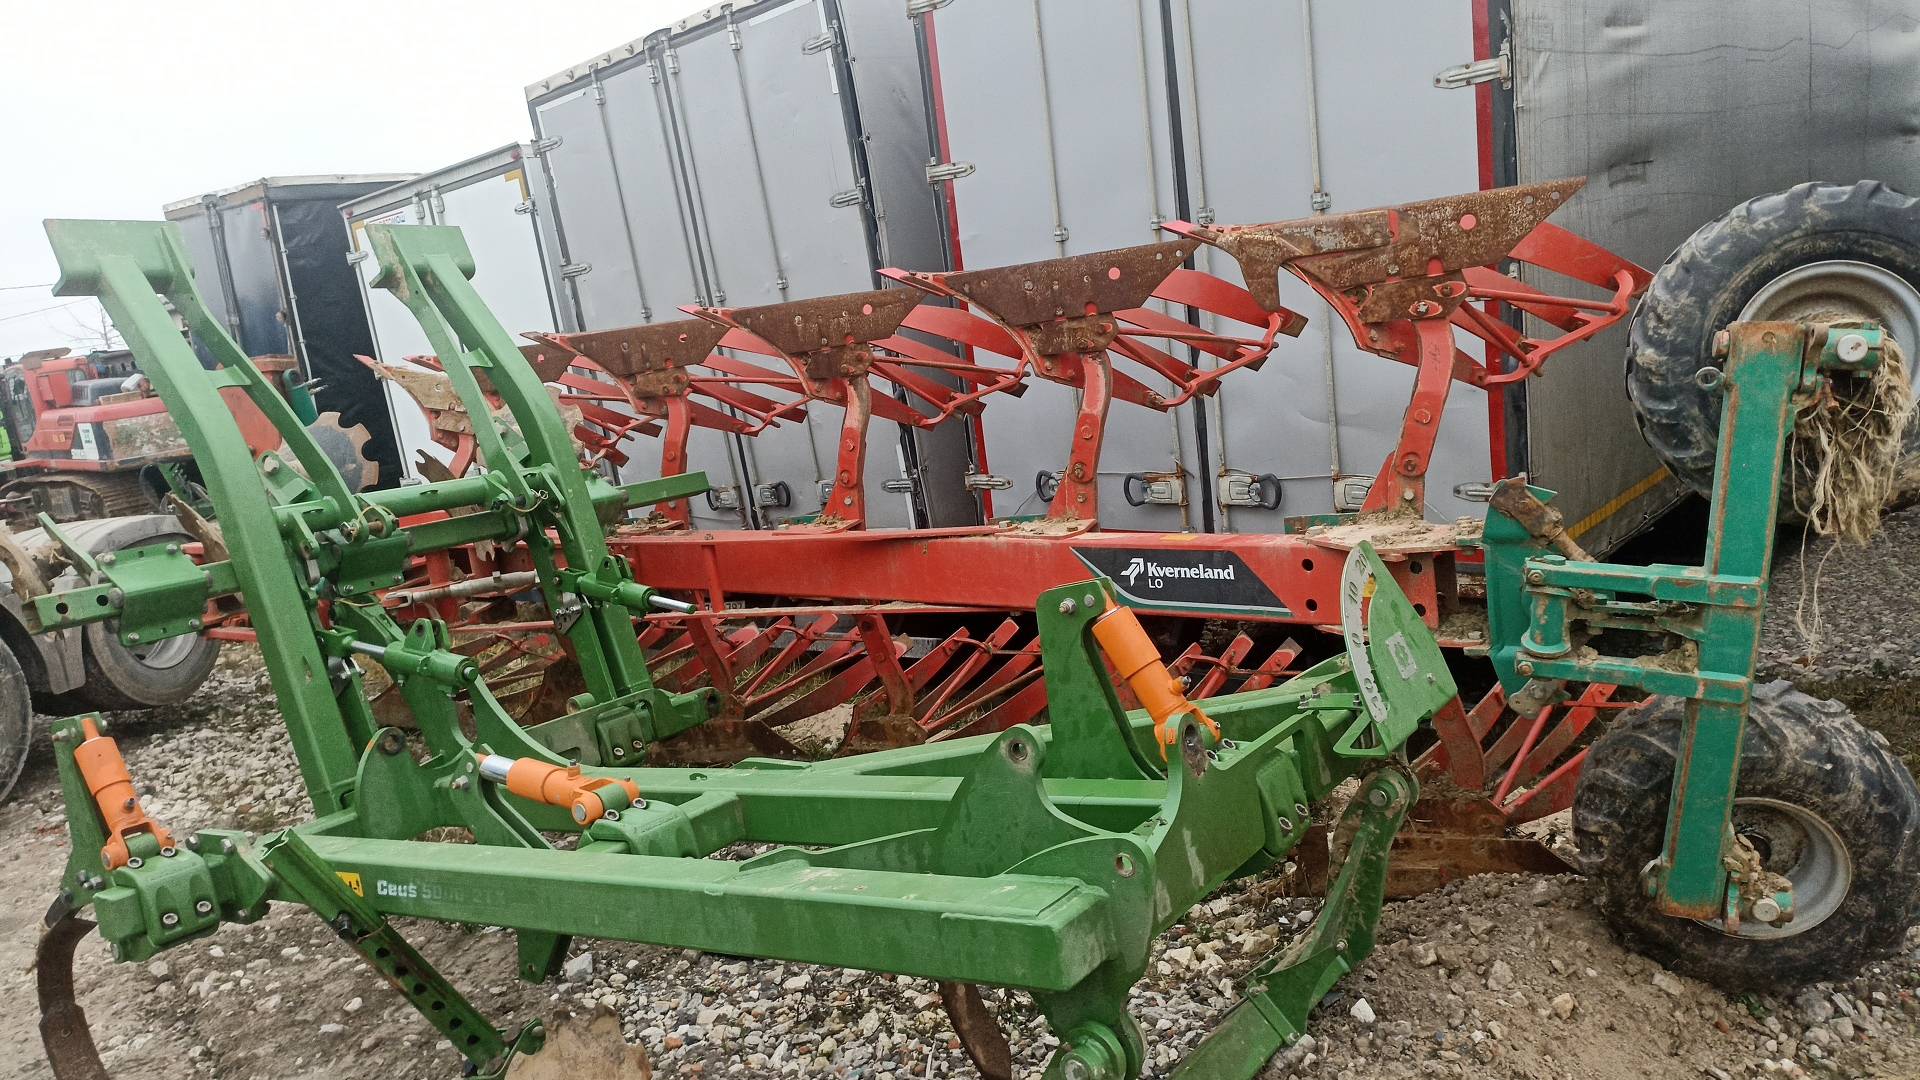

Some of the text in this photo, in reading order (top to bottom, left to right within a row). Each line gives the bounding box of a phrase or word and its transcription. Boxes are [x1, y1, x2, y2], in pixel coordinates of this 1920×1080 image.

[1146, 562, 1235, 580] Kverneland
[1148, 578, 1163, 589] LO
[376, 879, 418, 898] Ceus
